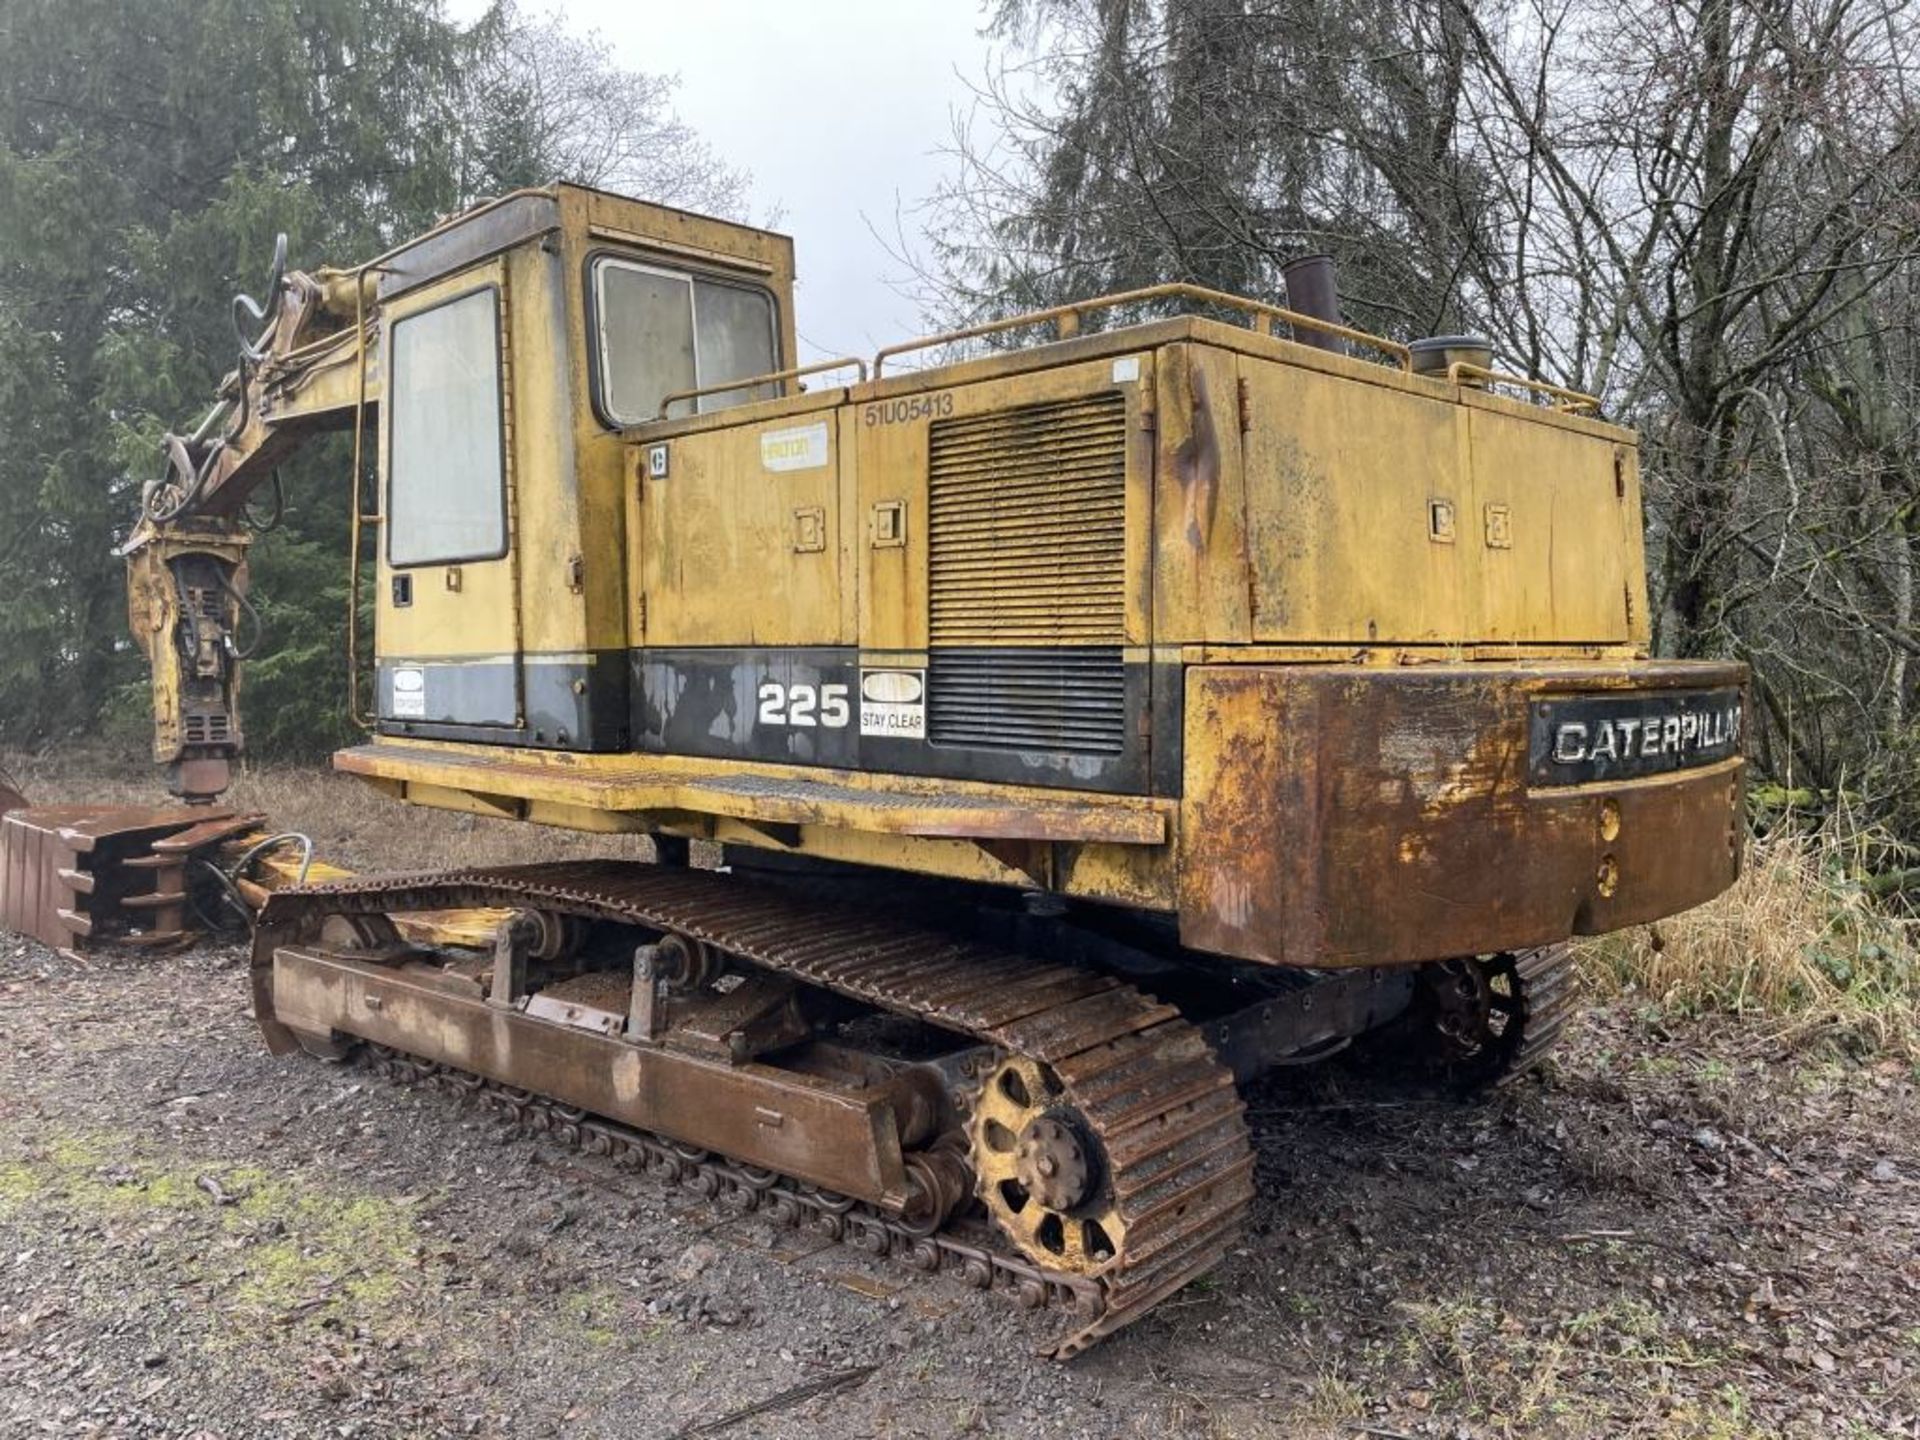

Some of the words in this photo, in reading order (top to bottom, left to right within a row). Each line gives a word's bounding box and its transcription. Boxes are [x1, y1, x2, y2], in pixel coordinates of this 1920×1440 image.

[865, 393, 953, 427] 51U05413
[758, 683, 850, 728] 225
[863, 712, 886, 727] STAY
[889, 713, 923, 729] CLEAR
